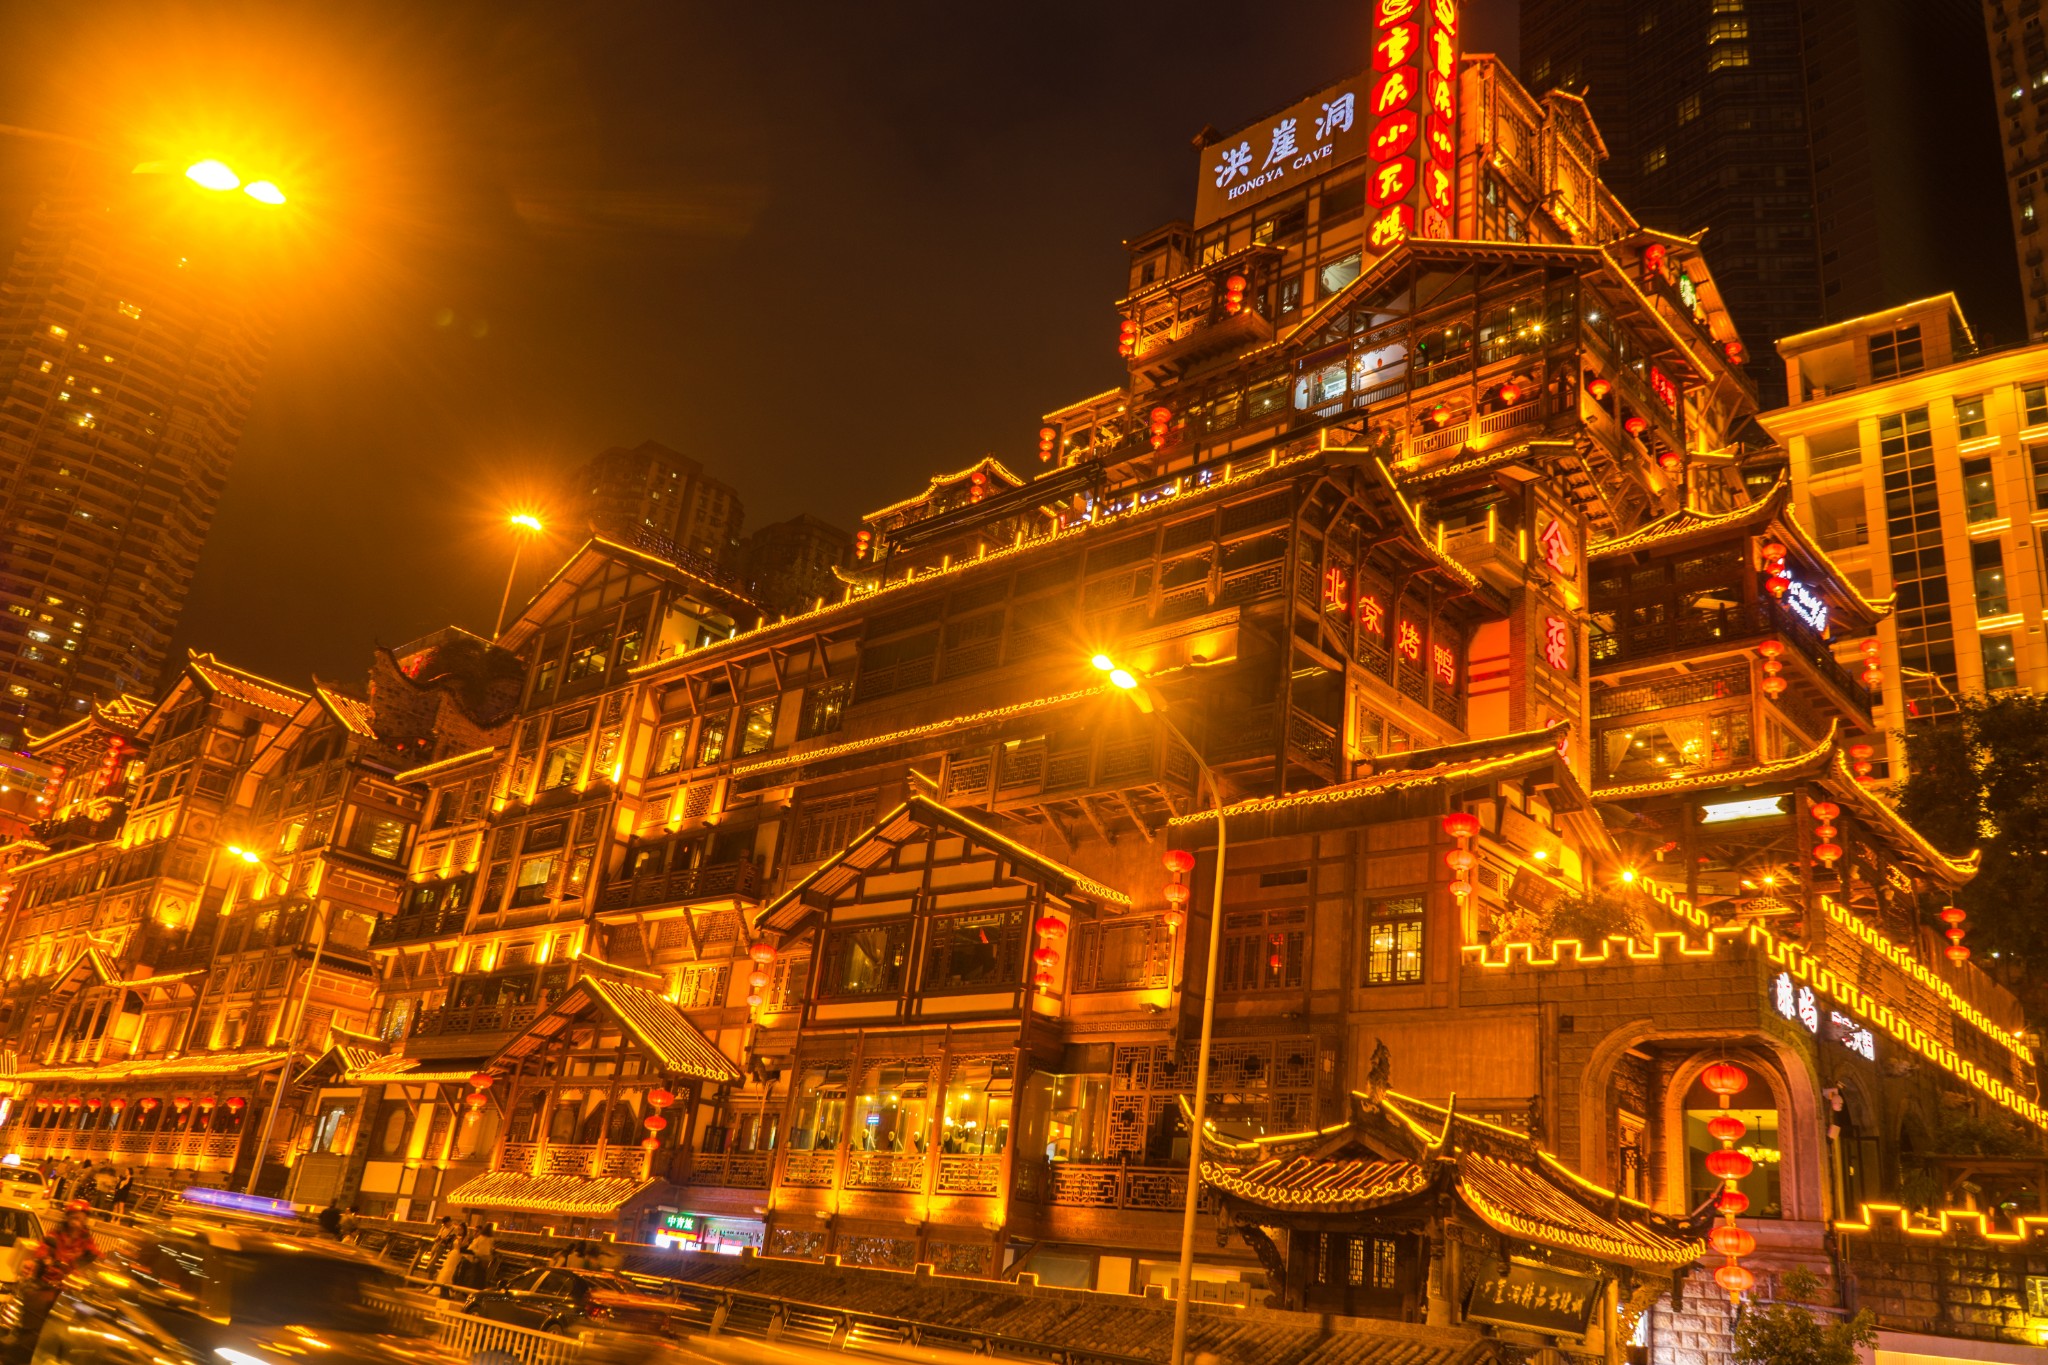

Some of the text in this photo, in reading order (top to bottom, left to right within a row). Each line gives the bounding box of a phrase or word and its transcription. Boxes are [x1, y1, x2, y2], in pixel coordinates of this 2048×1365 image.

[1214, 92, 1355, 188] 洪崖洞
[1227, 144, 1333, 200] HONGYA CAVE
[1325, 568, 1455, 684] 北京烤鸭
